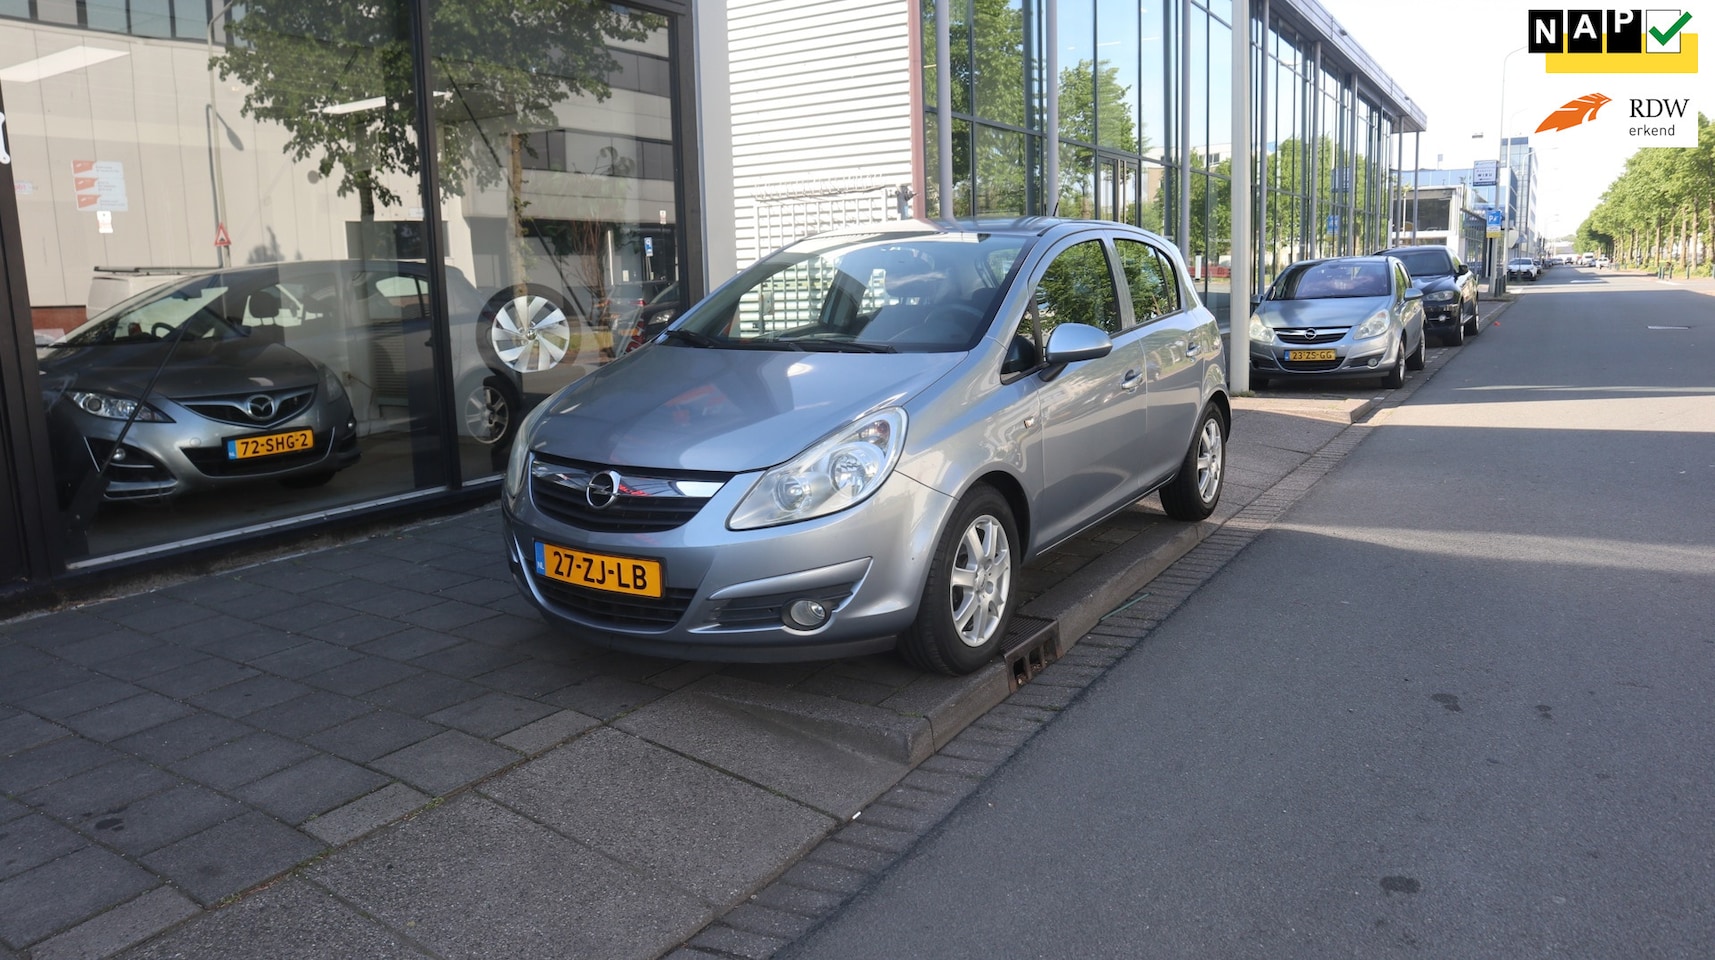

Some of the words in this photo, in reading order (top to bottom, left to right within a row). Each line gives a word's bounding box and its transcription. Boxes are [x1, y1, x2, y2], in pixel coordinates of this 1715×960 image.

[1293, 351, 1332, 359] 23-ZS-GG
[240, 433, 309, 456] 72-SHG-2
[536, 560, 545, 570] NL
[553, 551, 647, 590] 27-ZJ-LB
